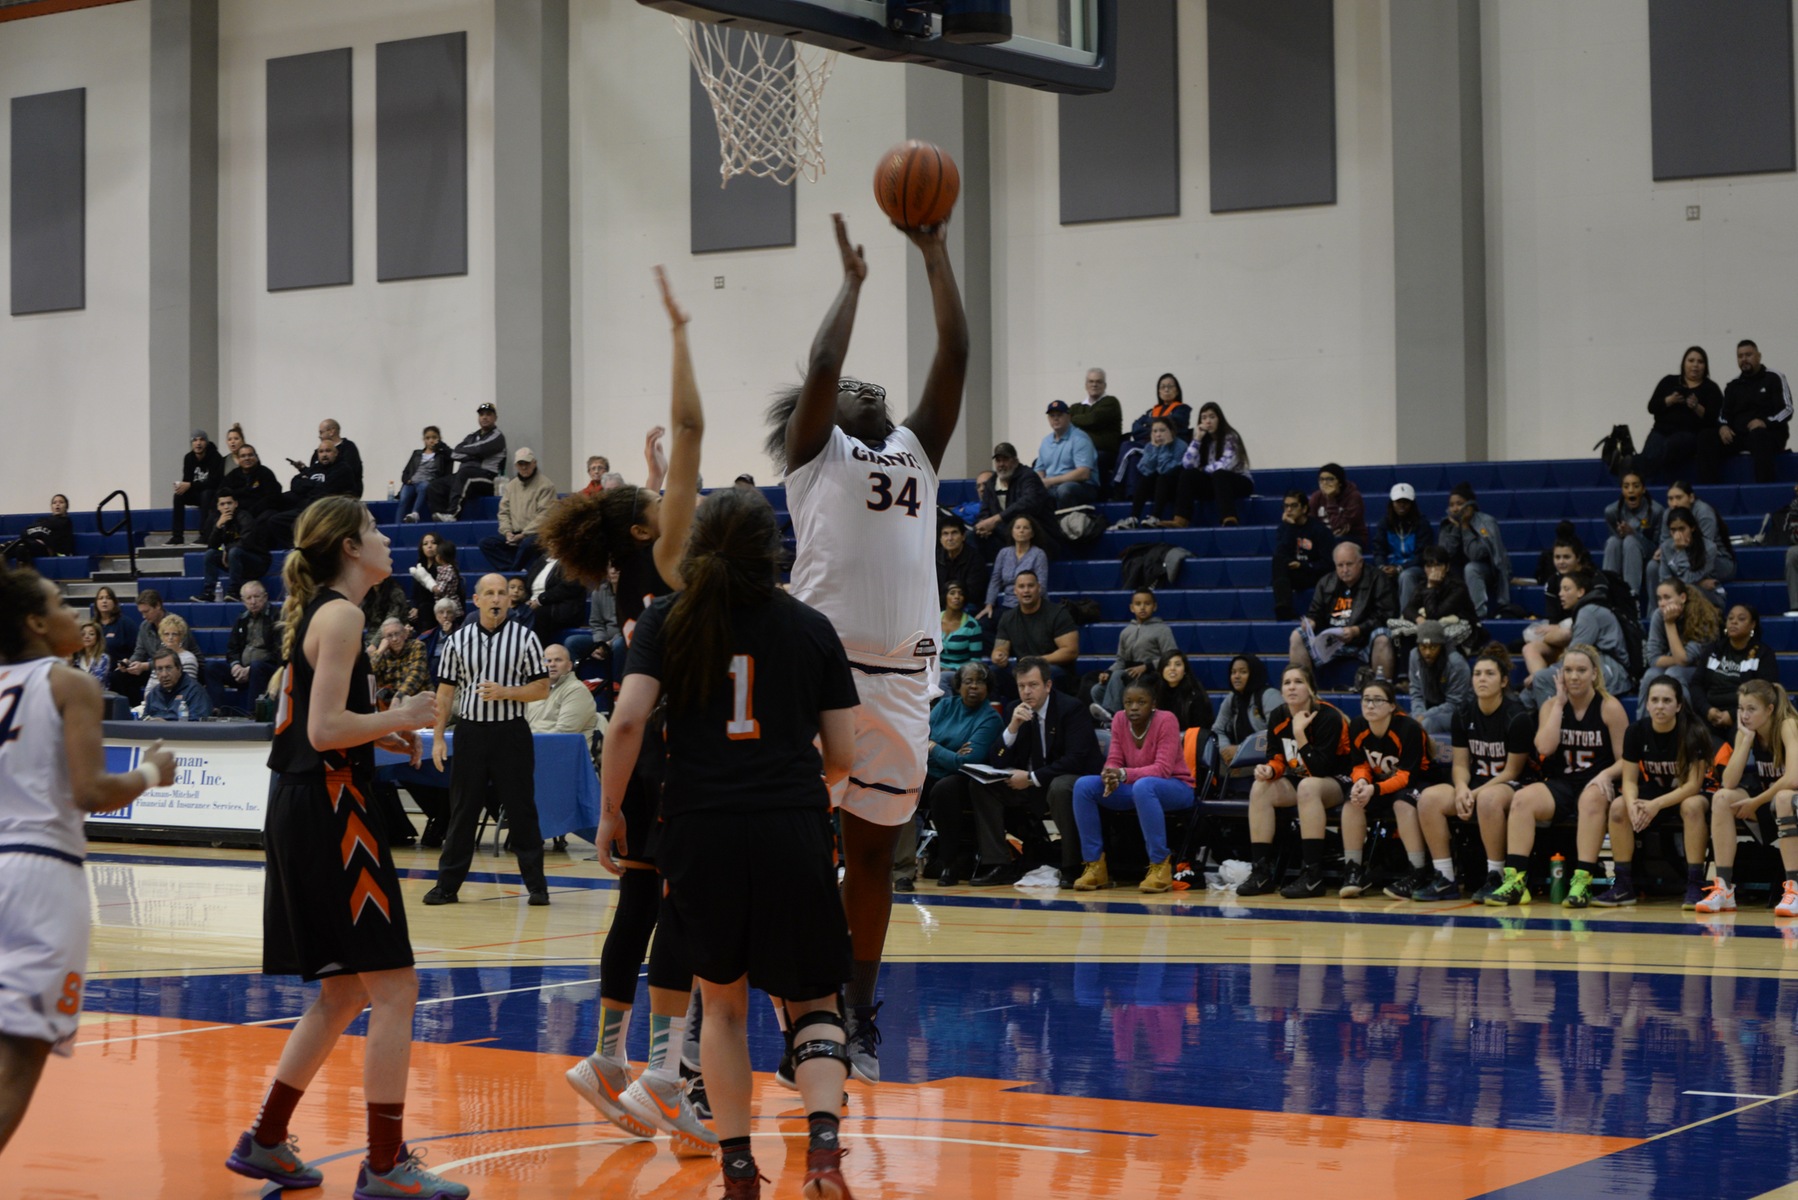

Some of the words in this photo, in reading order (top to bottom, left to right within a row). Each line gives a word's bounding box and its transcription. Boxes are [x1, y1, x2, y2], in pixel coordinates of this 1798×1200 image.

[866, 472, 921, 518] 34
[727, 654, 761, 740] 1
[1560, 729, 1604, 747] ENTURA
[174, 757, 208, 768] man-
[1563, 750, 1595, 774] 15
[200, 770, 225, 786] Inc.
[135, 798, 167, 808] Financial
[168, 799, 174, 808] &
[176, 799, 211, 810] Insurance
[245, 801, 260, 811] Inc.
